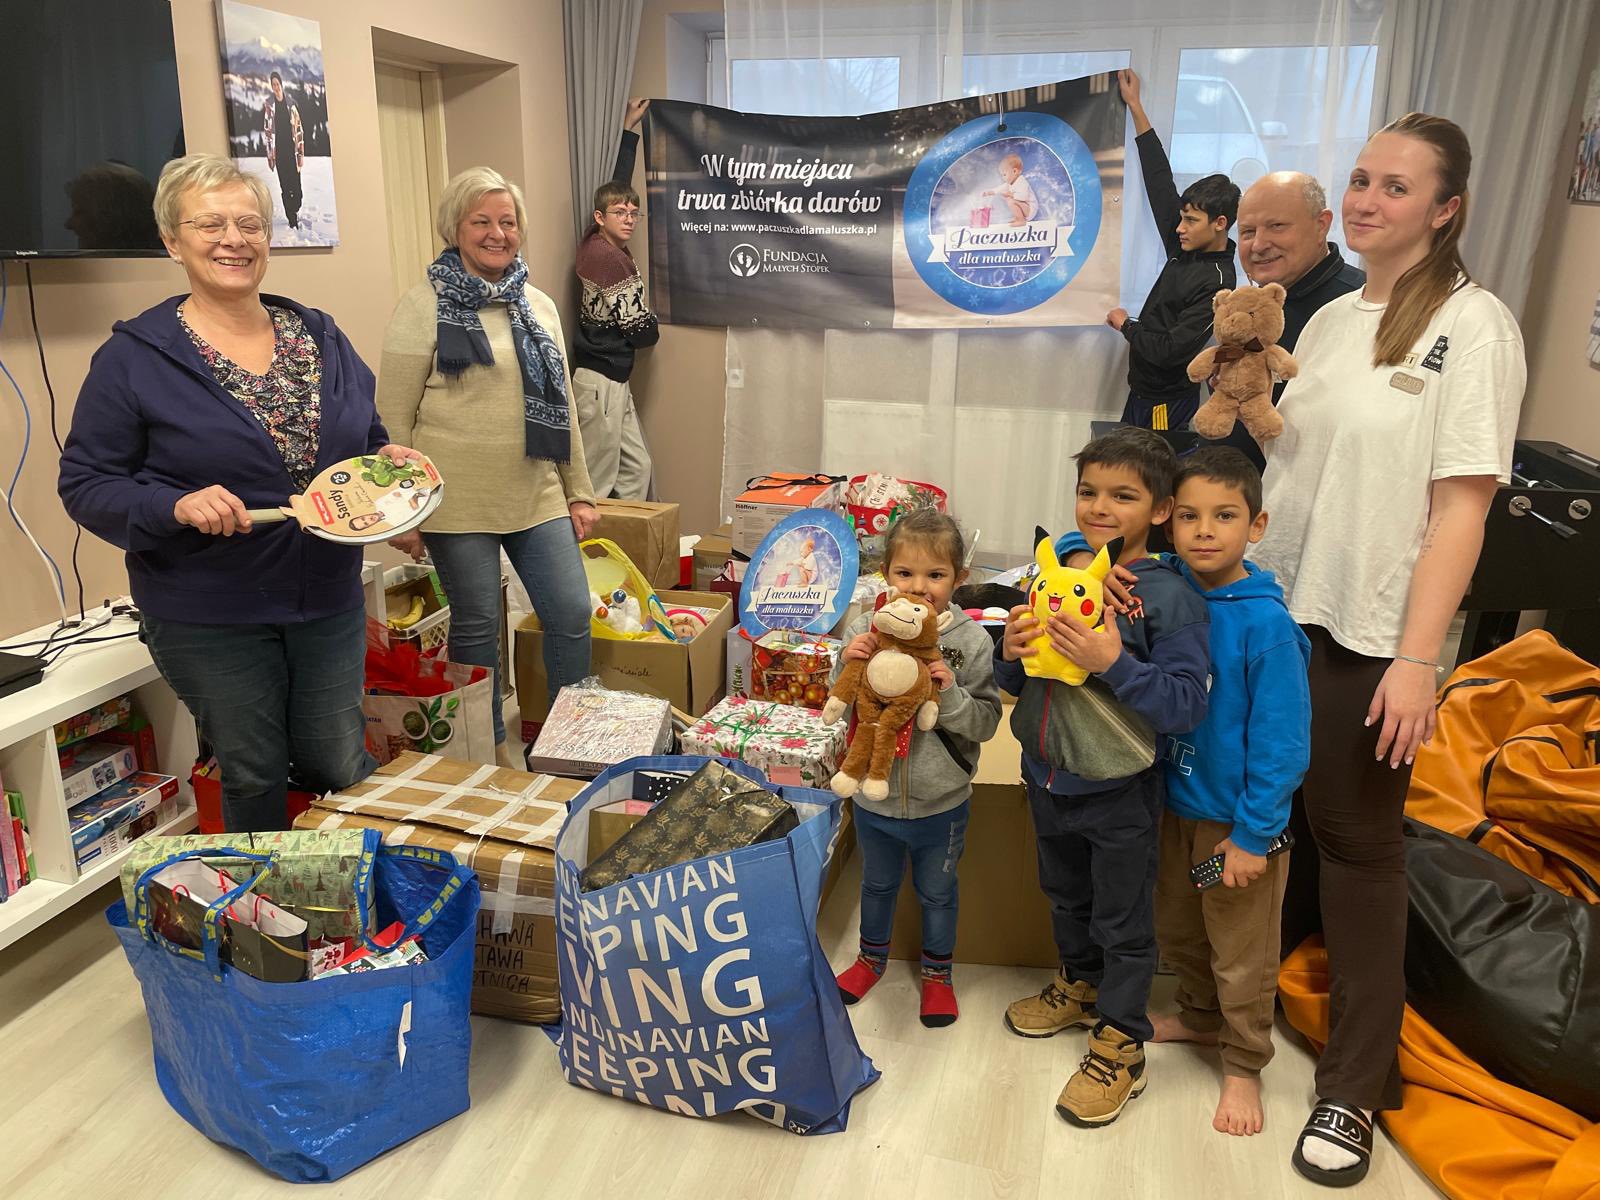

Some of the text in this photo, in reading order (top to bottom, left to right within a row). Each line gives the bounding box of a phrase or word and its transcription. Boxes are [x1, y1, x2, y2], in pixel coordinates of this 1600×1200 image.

[701, 154, 854, 187] W tym miejscu
[677, 188, 881, 214] trwa zbiórka darów
[680, 222, 877, 235] Więcej na: www.paczuszkadlamaluszka.pl
[950, 225, 1048, 249] Paczuszka
[763, 249, 828, 264] FUNDACJA
[959, 252, 979, 265] dla
[329, 489, 350, 519] Sandy
[762, 586, 821, 602] Paczuszka
[762, 604, 775, 613] dla
[107, 832, 118, 853] 1000
[417, 876, 461, 926] IKEA
[1314, 1111, 1362, 1143] FILA
